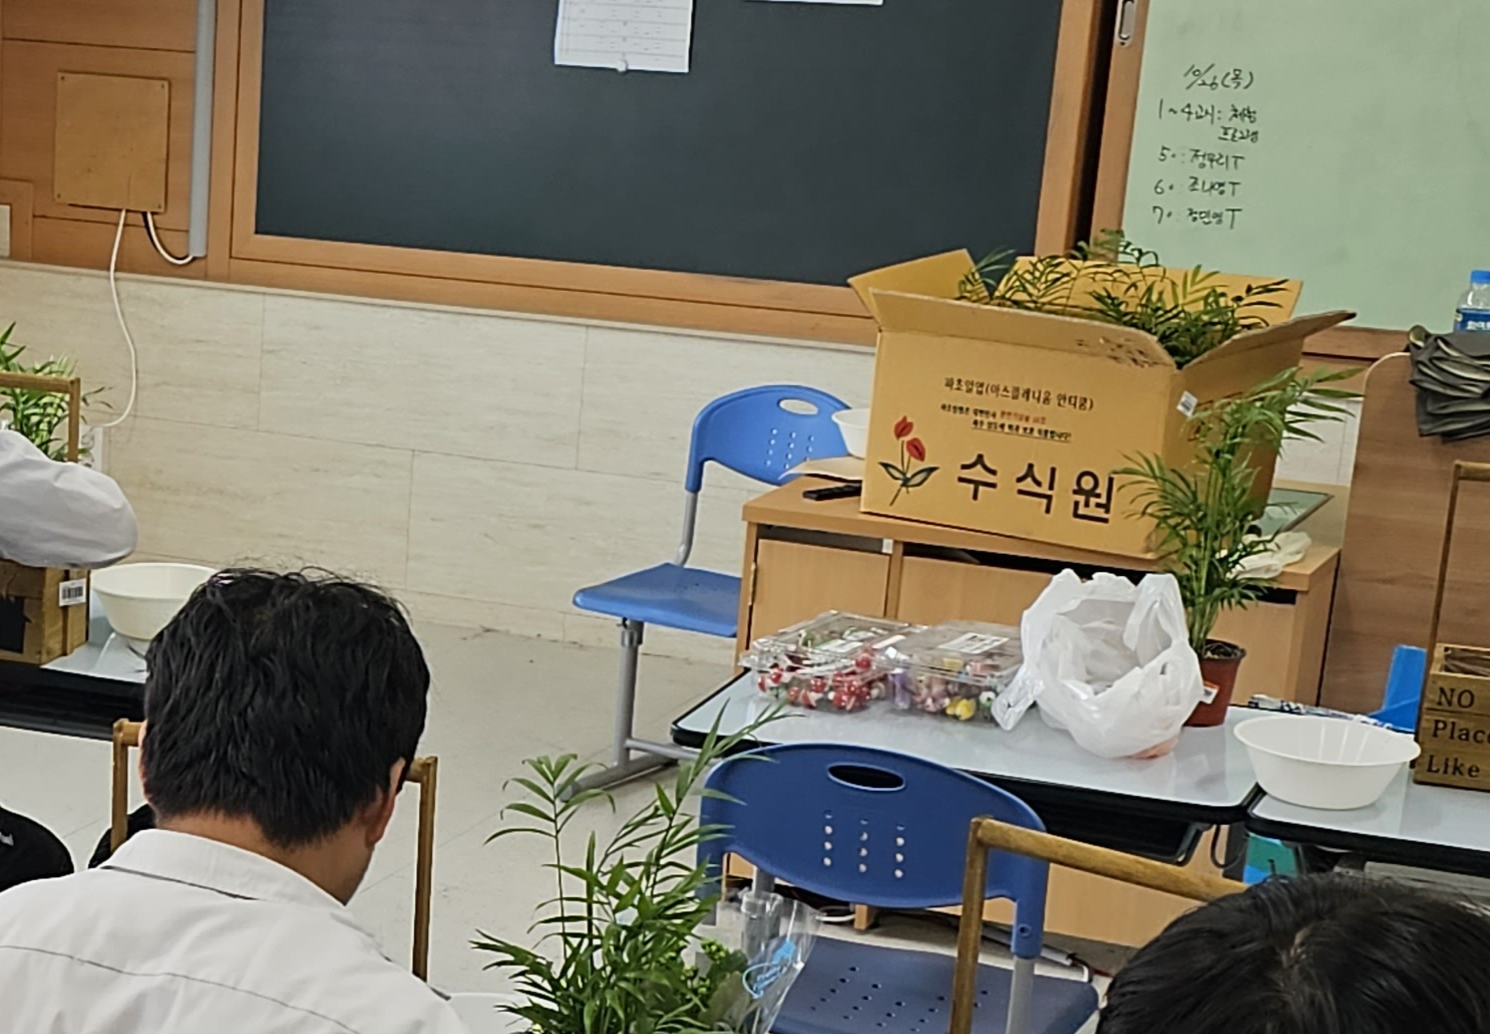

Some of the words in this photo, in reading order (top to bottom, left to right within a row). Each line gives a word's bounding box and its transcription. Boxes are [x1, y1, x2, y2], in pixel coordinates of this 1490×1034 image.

[957, 453, 1115, 524] 수식원
[1437, 686, 1475, 709] NO
[1432, 719, 1490, 745] Plac
[1426, 755, 1480, 778] Like
